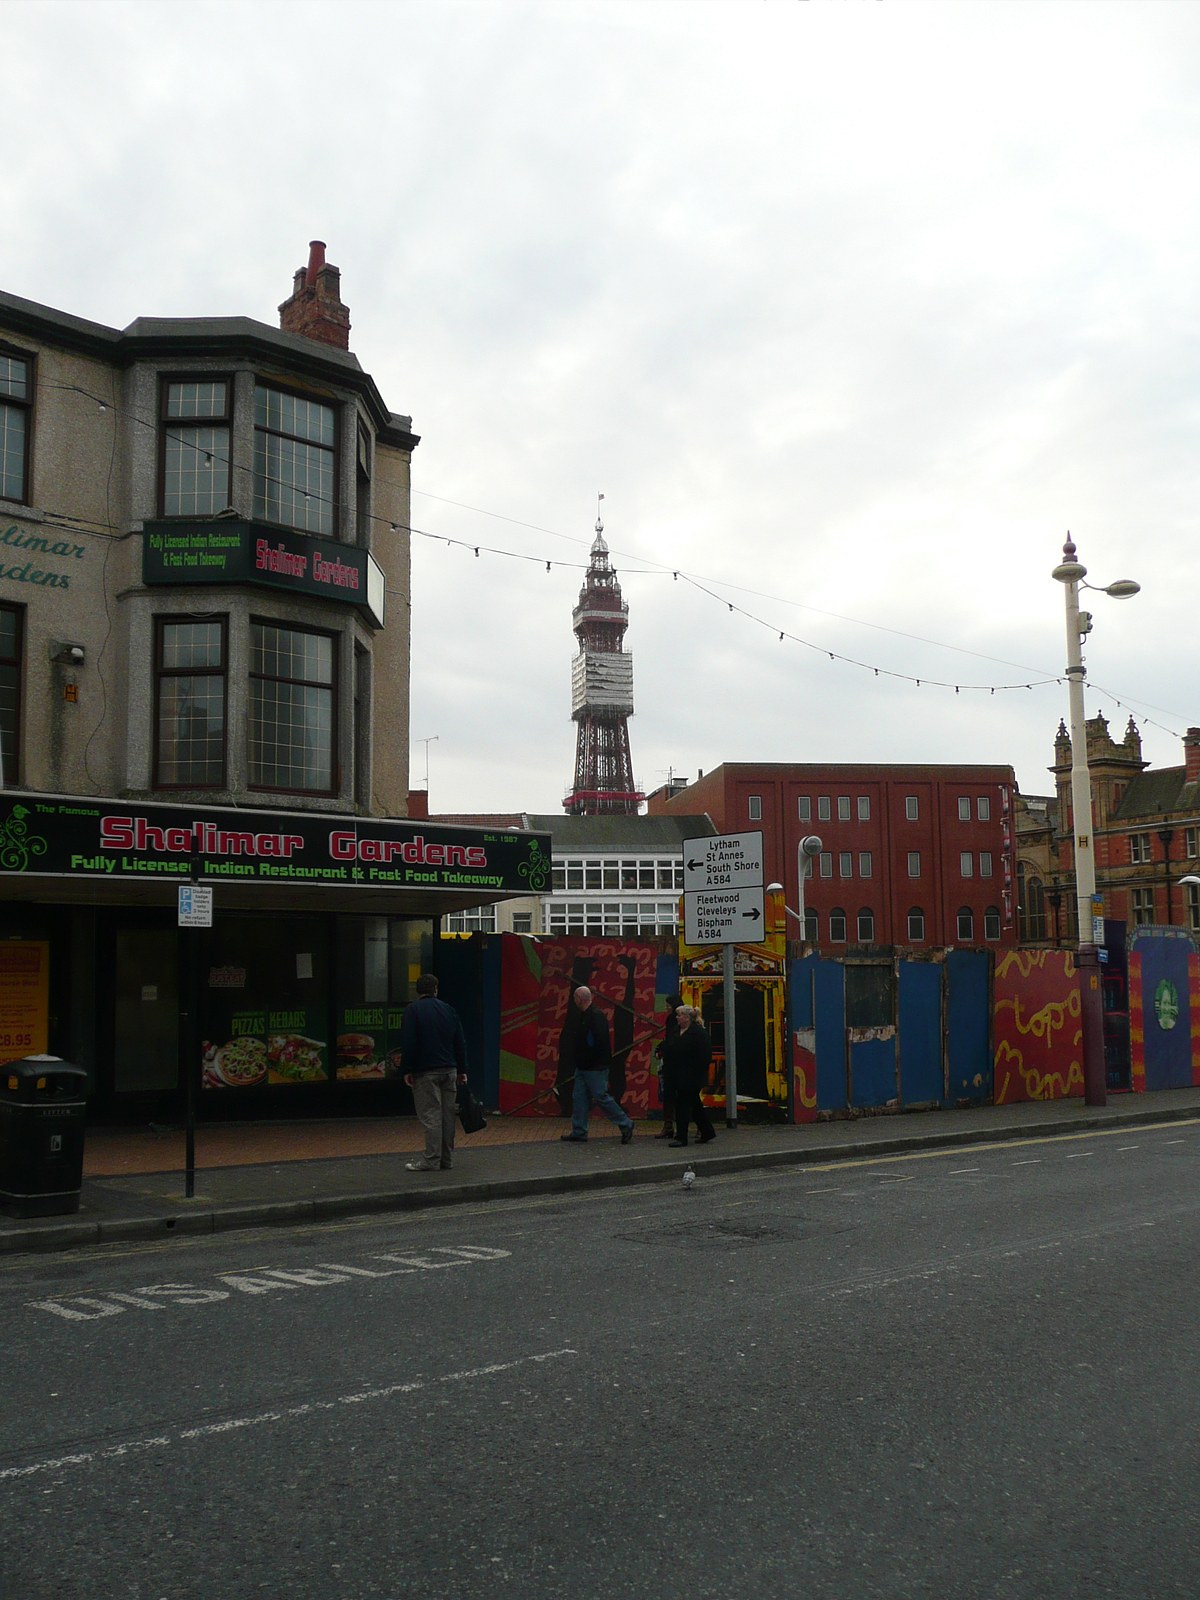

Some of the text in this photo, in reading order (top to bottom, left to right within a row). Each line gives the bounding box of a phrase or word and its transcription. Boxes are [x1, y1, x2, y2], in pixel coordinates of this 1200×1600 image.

[149, 533, 240, 551] Fully Licensed Indian Restaurant
[163, 552, 226, 570] & Fast Food Takeaway
[256, 538, 359, 590] Shalimar Gardens
[35, 804, 100, 816] The Famous
[100, 815, 487, 867] Shalimar Gardens
[709, 840, 740, 851] Lytham
[706, 851, 744, 862] St Annes
[71, 855, 117, 873] Fully
[204, 861, 254, 875] Indian
[258, 862, 348, 879] Restaurant
[352, 867, 364, 879] &
[370, 868, 401, 881] Fast
[405, 869, 438, 882] Food
[441, 871, 504, 887] Takeaway
[706, 862, 760, 874] South Shore
[182, 889, 190, 899] P
[697, 893, 740, 904] Fleetwood
[697, 906, 737, 917] Cleveleys
[697, 918, 733, 928] Bispham
[269, 1010, 306, 1029] KEBABS
[344, 1008, 384, 1026] BURGERS
[231, 1017, 265, 1036] PIZZAS
[25, 1244, 512, 1320] DISABLED
